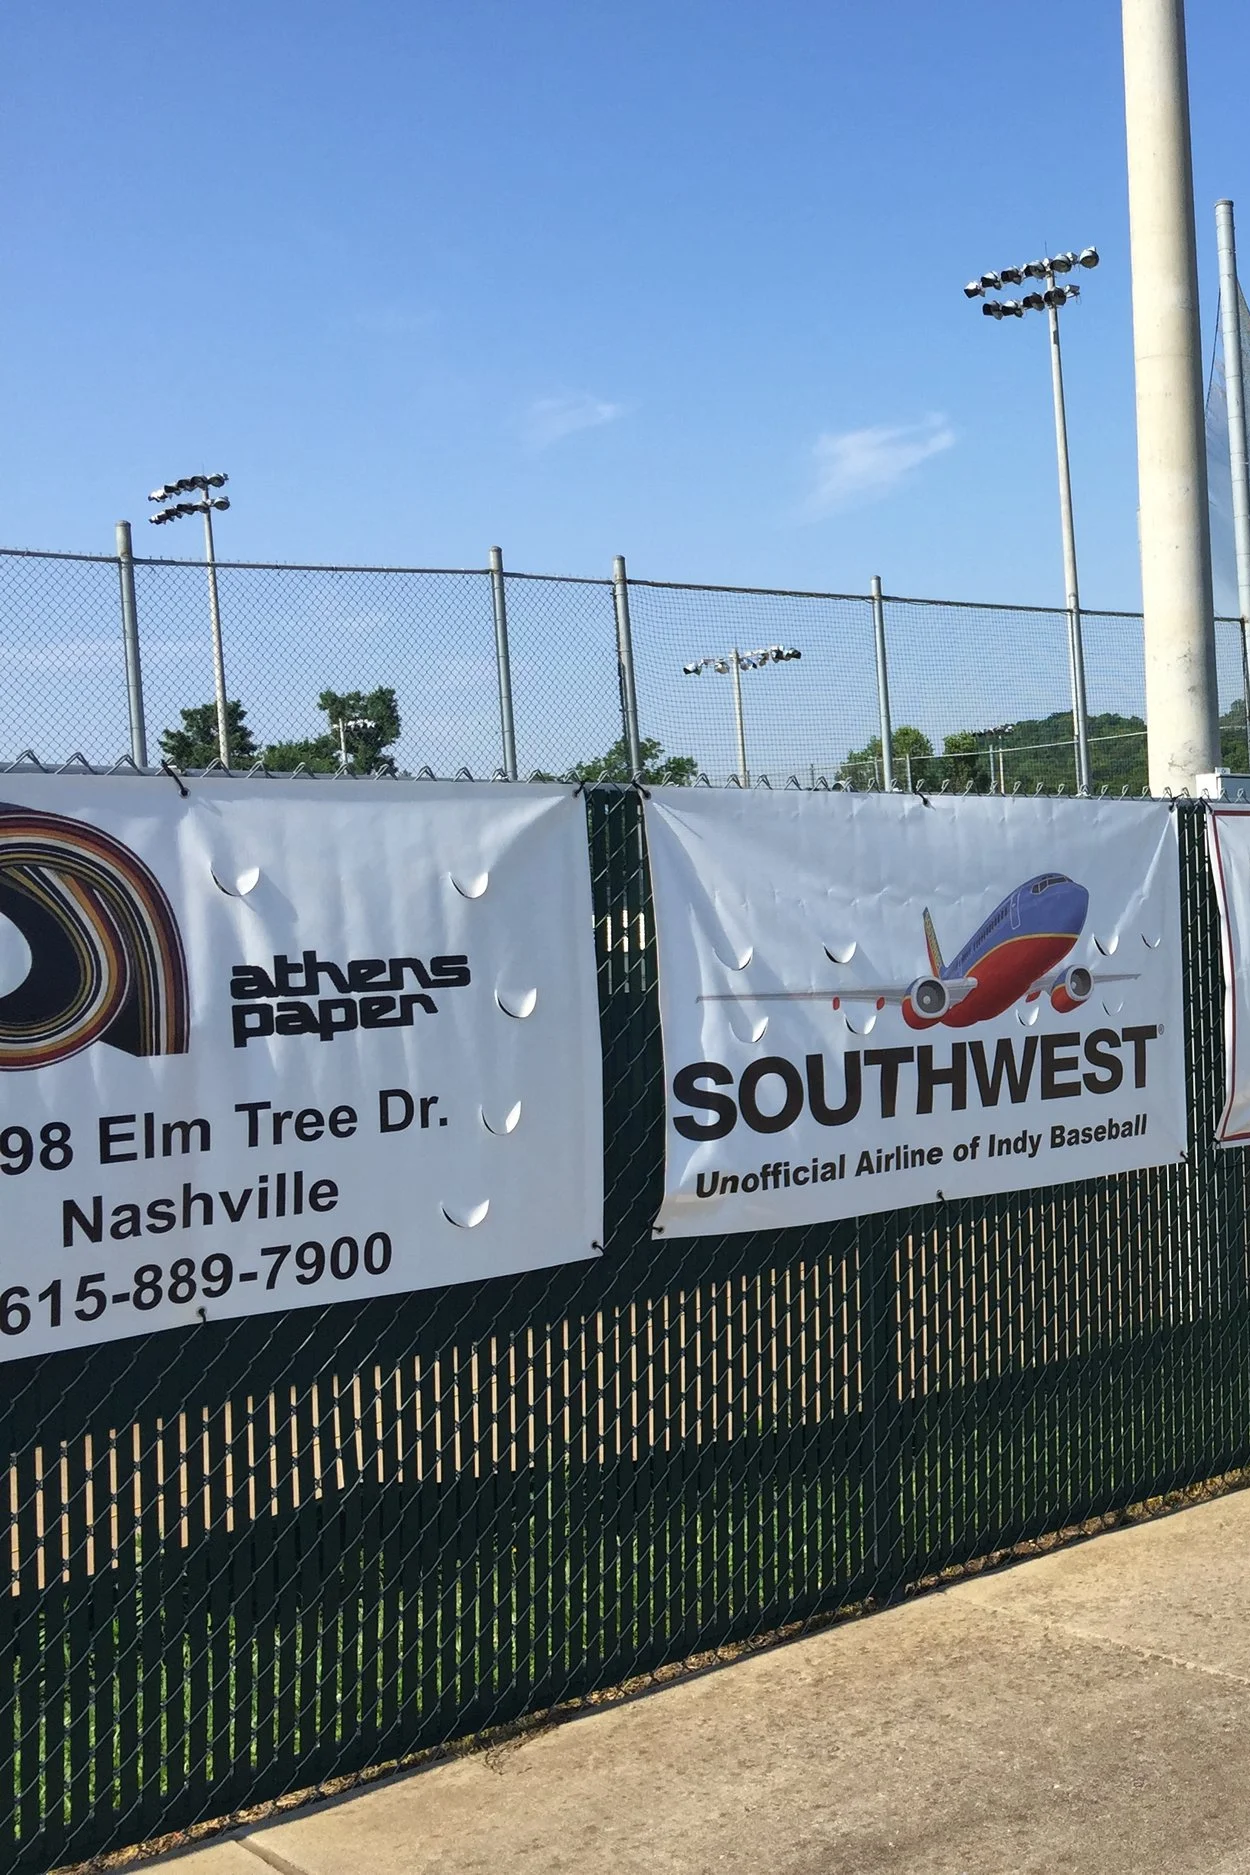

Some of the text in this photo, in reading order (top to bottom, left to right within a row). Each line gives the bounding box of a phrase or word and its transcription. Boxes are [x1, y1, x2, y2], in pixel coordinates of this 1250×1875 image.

[230, 950, 471, 999] athens
[232, 993, 438, 1048] paper
[672, 1024, 1158, 1142] SOUTHWEST
[99, 1111, 212, 1164] Elm
[235, 1099, 358, 1148] Tree
[378, 1087, 448, 1134] Dr.
[695, 1113, 1147, 1199] Unofficial Airline of Indy Baseball
[62, 1171, 340, 1248] Nashville
[0, 1231, 393, 1336] 615-889-7900
